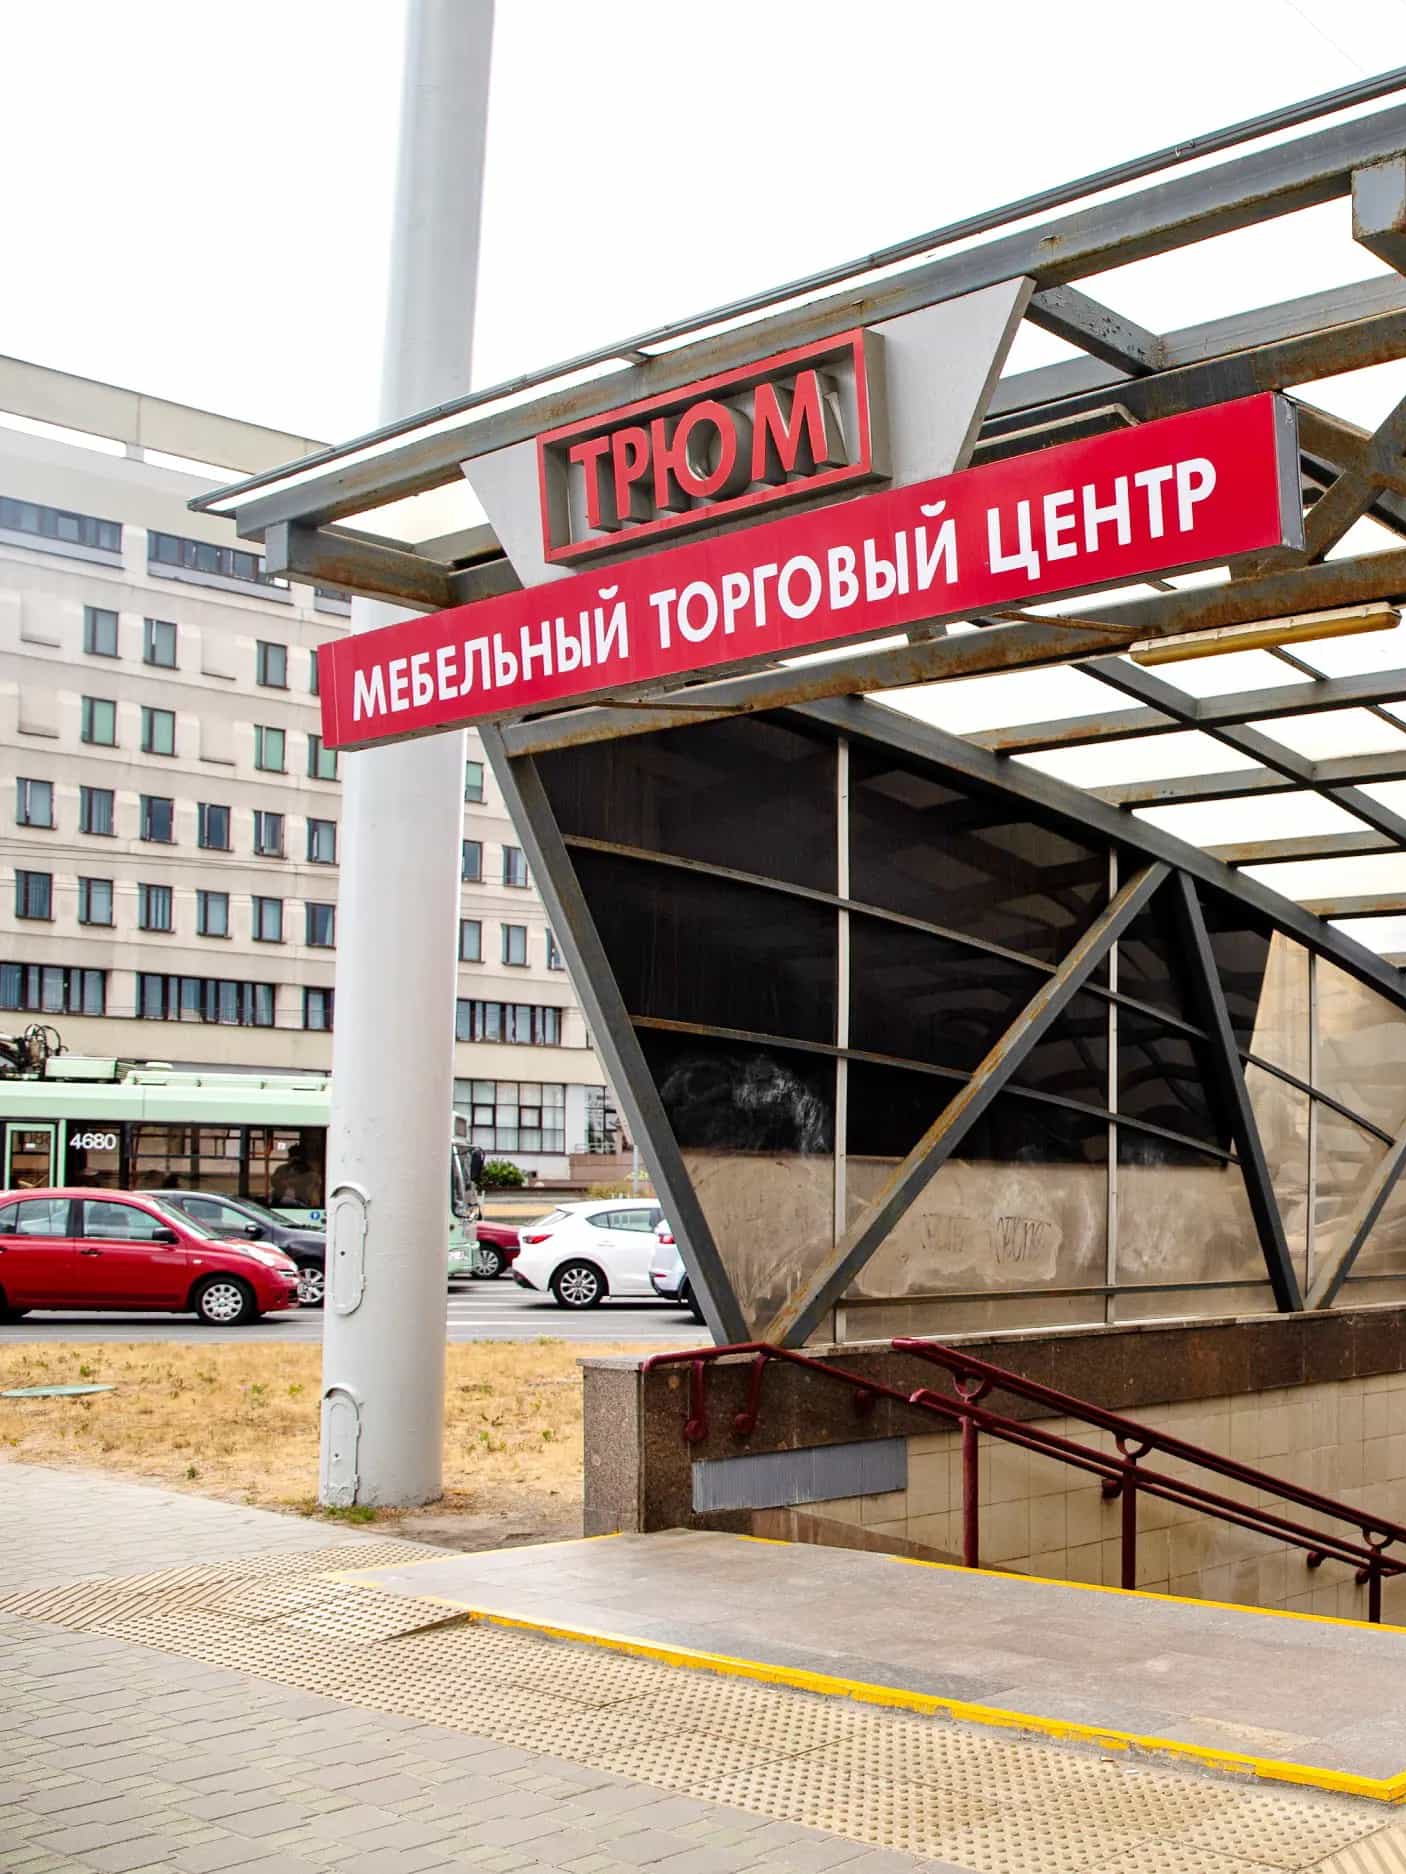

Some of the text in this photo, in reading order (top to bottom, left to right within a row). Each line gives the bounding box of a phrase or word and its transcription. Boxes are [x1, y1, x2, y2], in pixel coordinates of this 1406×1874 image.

[568, 368, 829, 530] ТРЮМ
[352, 457, 1218, 723] МЕБЕЛЬНЫЙ ТОРГОВЫЙ ЦЕНТР
[69, 1132, 118, 1151] 4680
